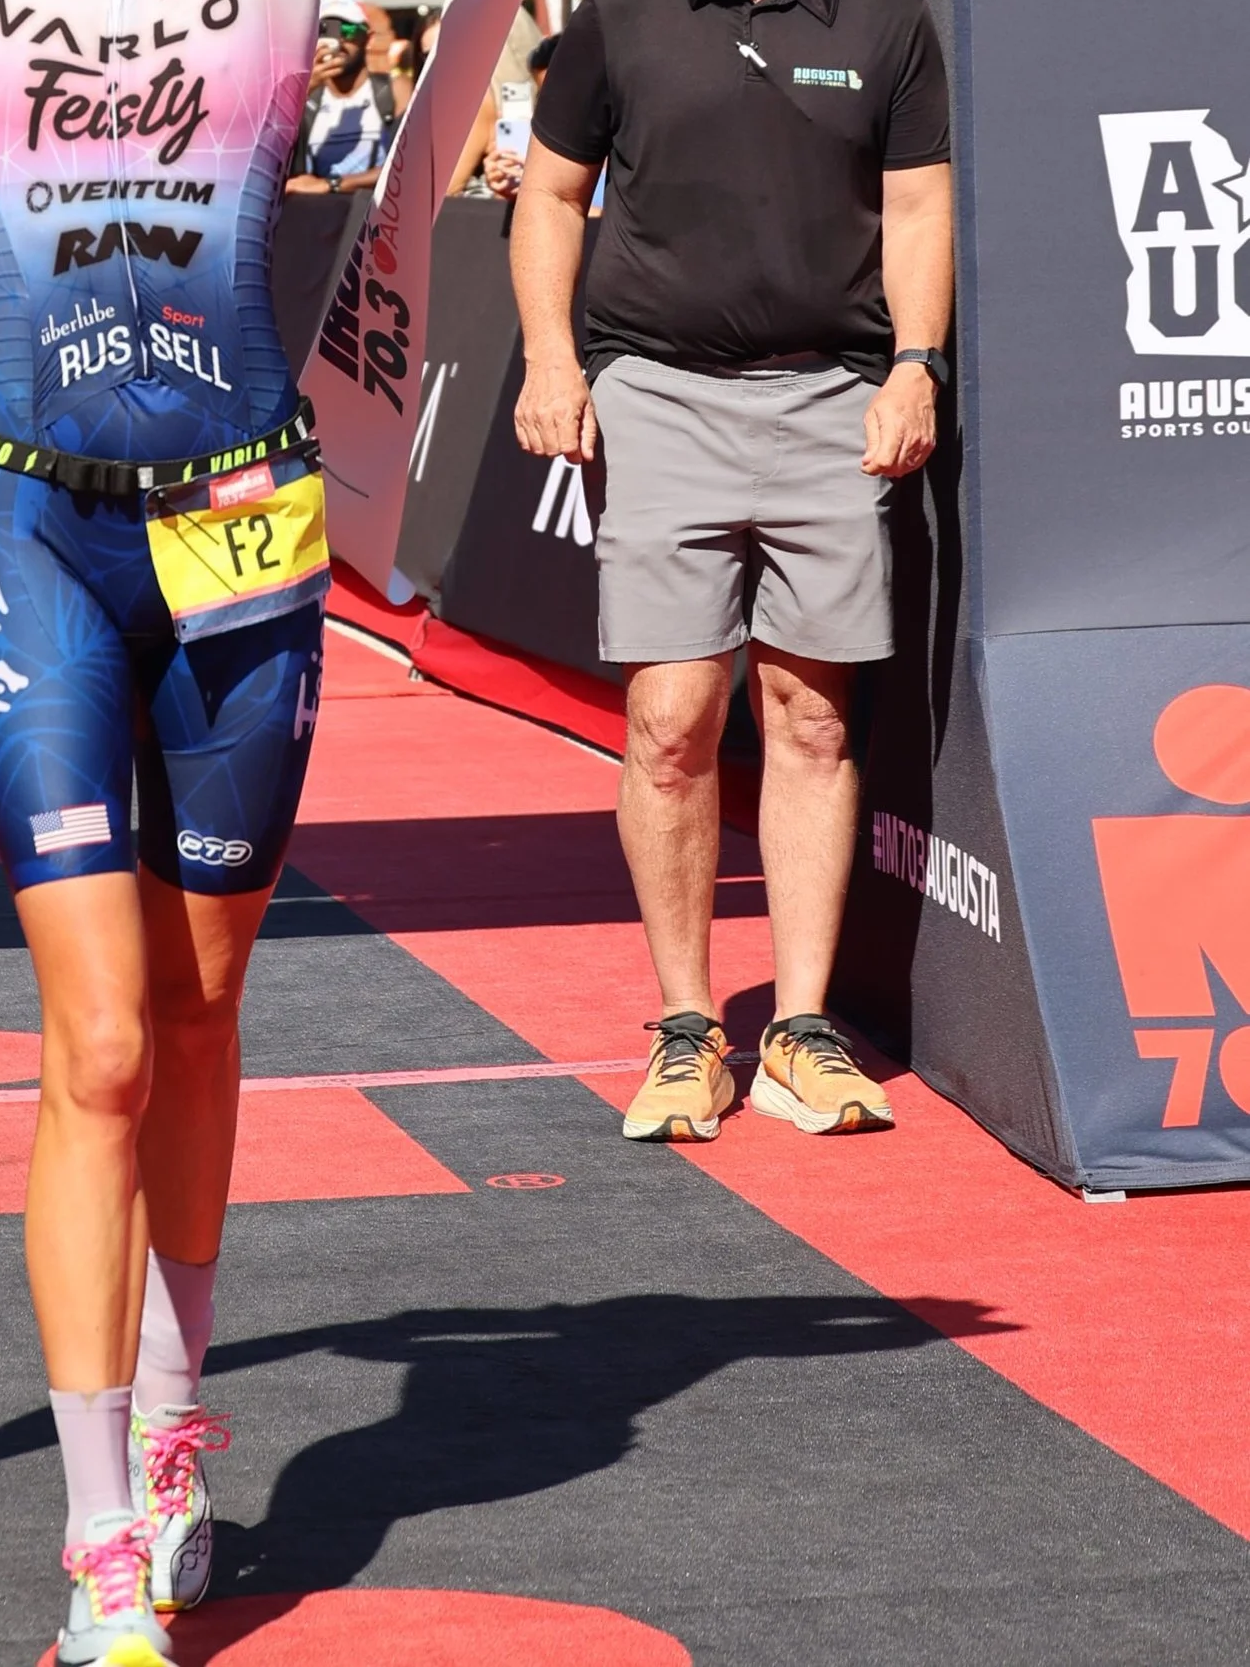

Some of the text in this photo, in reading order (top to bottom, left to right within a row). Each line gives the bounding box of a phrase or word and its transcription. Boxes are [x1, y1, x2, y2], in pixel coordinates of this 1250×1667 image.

[793, 67, 847, 82] AUGUSTA
[24, 56, 210, 166] Feisty
[58, 180, 215, 206] VENTUM
[53, 220, 204, 277] RAW
[161, 305, 206, 329] Sport
[363, 277, 410, 418] 70.3
[1121, 422, 1204, 438] SPORTS
[223, 514, 281, 578] F2
[179, 831, 252, 866] PTO
[872, 811, 1001, 944] #IM703AUGUSTA
